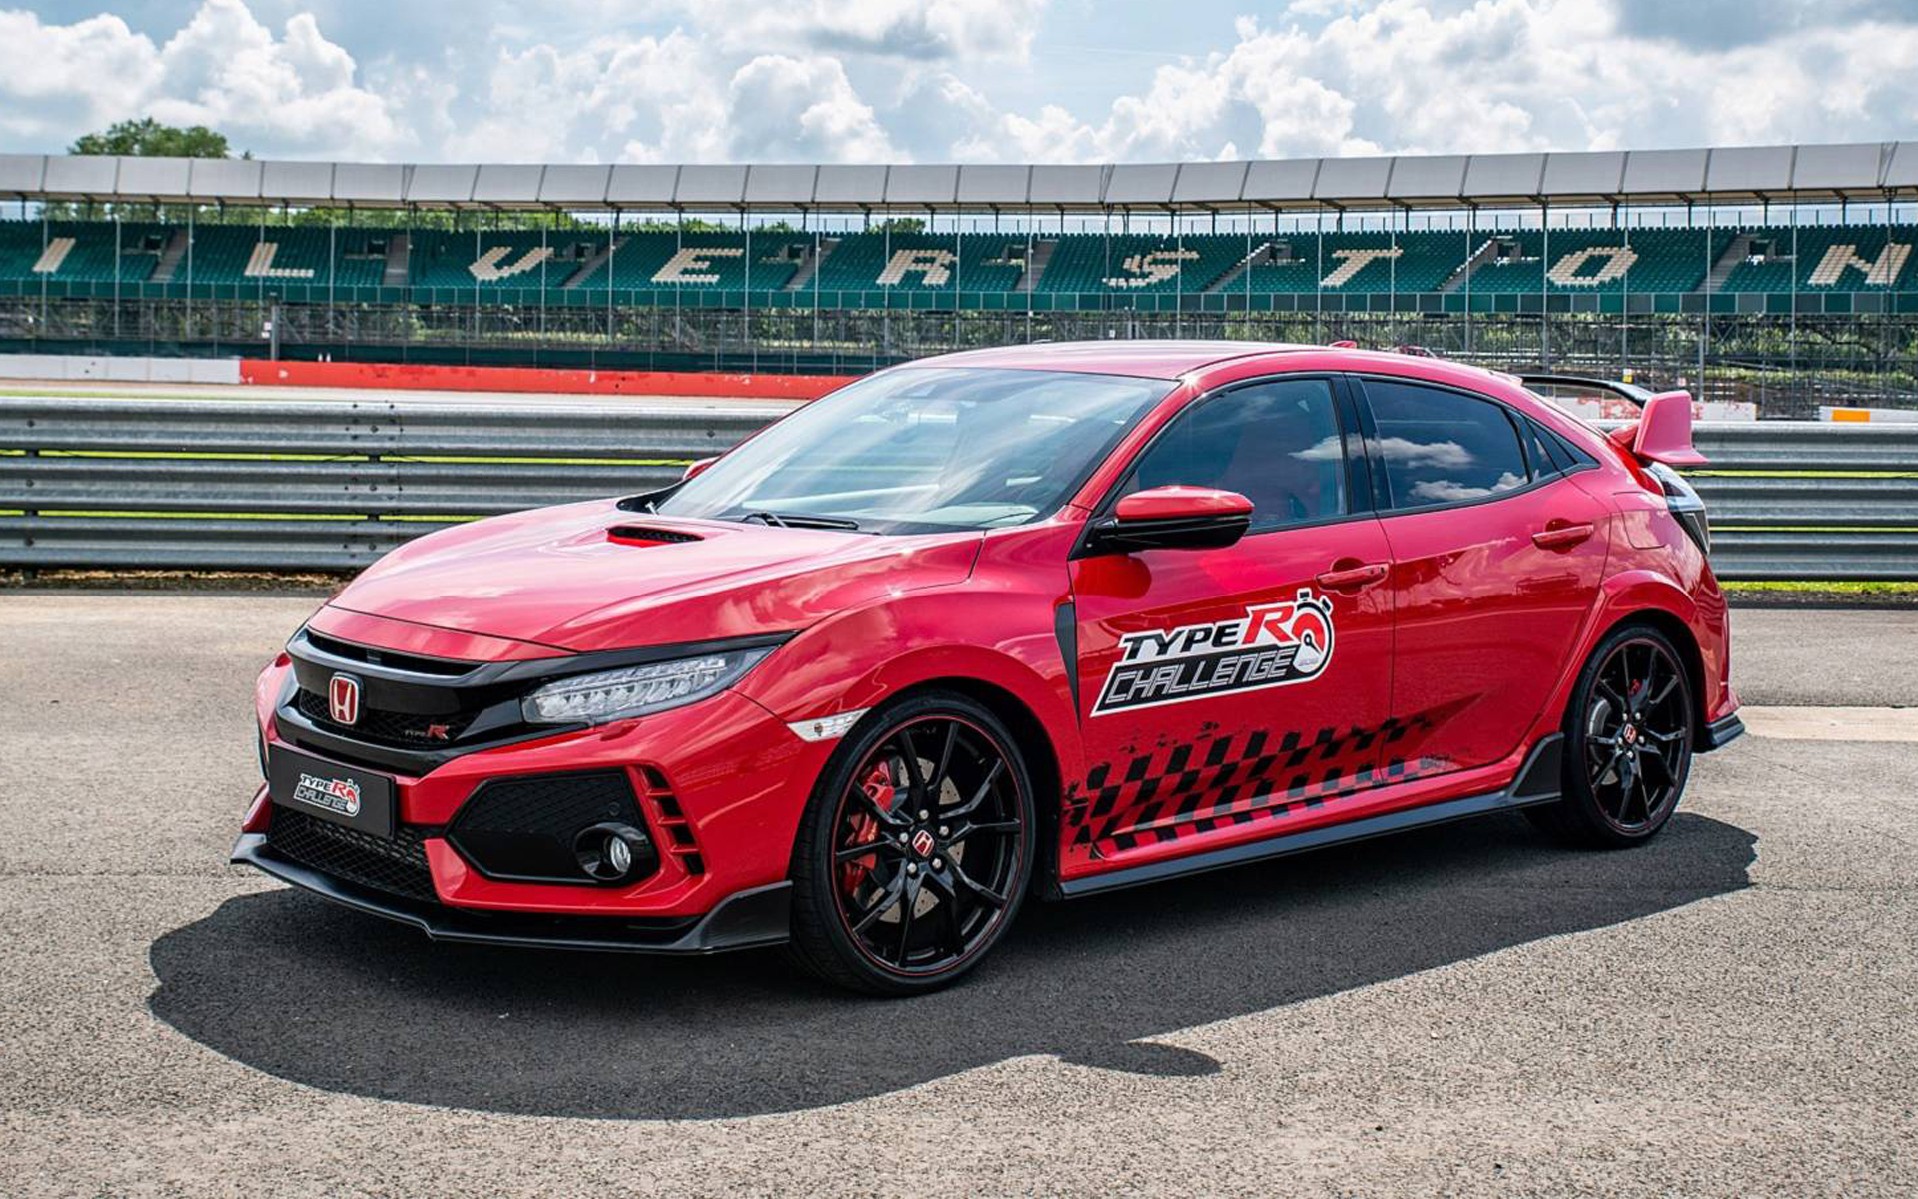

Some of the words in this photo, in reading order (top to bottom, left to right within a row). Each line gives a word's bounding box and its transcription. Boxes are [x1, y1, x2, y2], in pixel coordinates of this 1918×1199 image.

[1122, 623, 1241, 661] TYPE
[1242, 605, 1296, 644] R
[1104, 648, 1299, 704] CHALLENGE
[297, 786, 348, 810] CHALLENGE
[301, 775, 333, 791] TYPE
